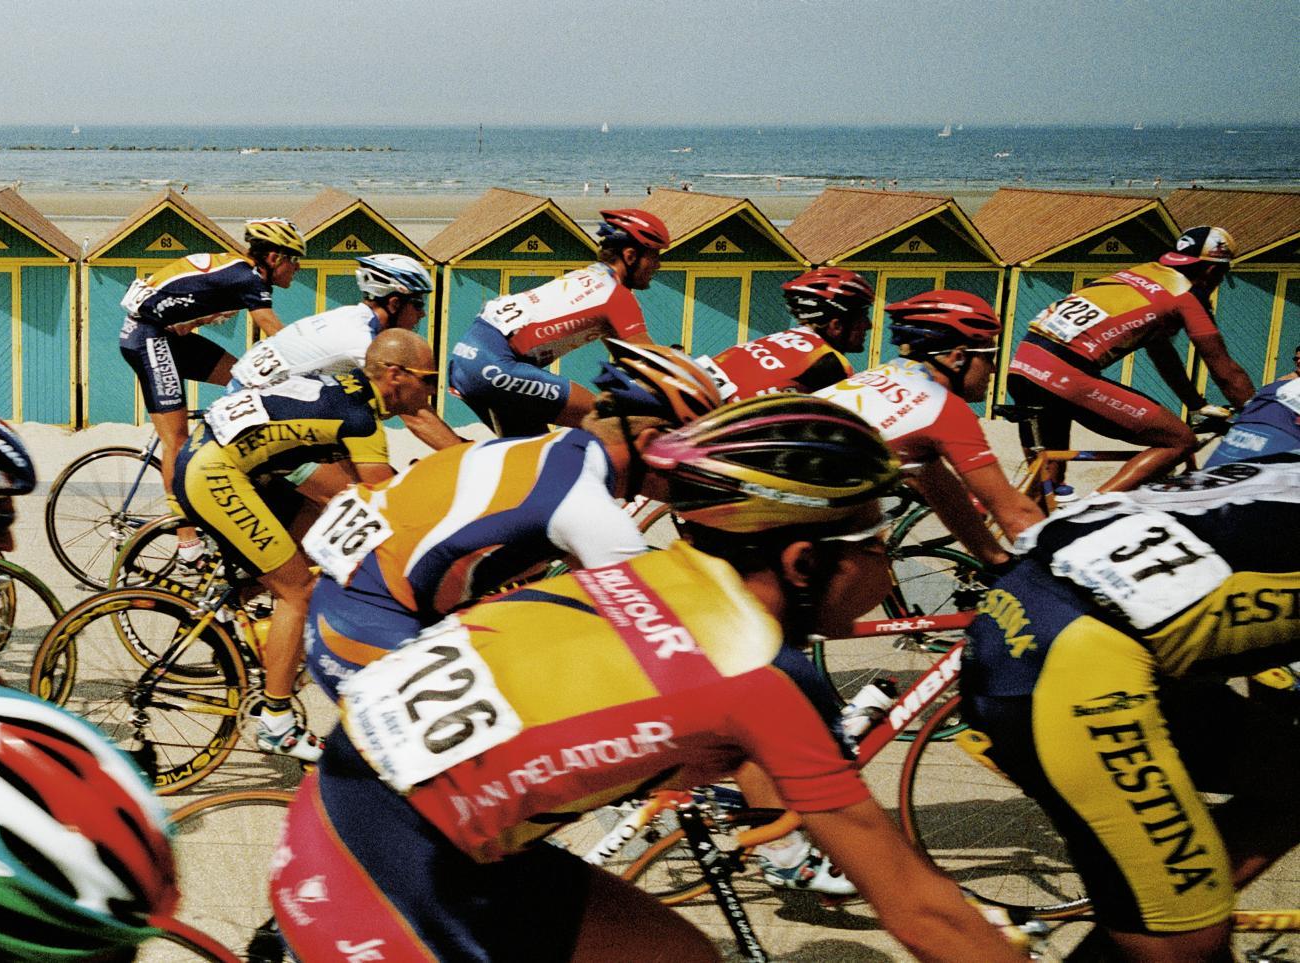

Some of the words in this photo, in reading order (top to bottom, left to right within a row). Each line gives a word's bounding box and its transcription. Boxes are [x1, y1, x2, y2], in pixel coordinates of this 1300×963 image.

[160, 238, 172, 249] 63
[345, 239, 358, 250] 64
[527, 240, 539, 251] 65
[715, 240, 727, 251] 66
[908, 240, 920, 251] 67
[1105, 241, 1119, 252] 68
[1059, 298, 1101, 332] 128
[481, 364, 561, 401] COFIDIS
[235, 423, 318, 458] FESTINA
[206, 474, 276, 551] FESTINA
[322, 498, 382, 556] 156
[1110, 526, 1205, 582] 37
[875, 619, 936, 632] mbk.fr
[397, 645, 498, 755] 126
[889, 646, 964, 731] MBK
[1087, 720, 1216, 895] FESTINA
